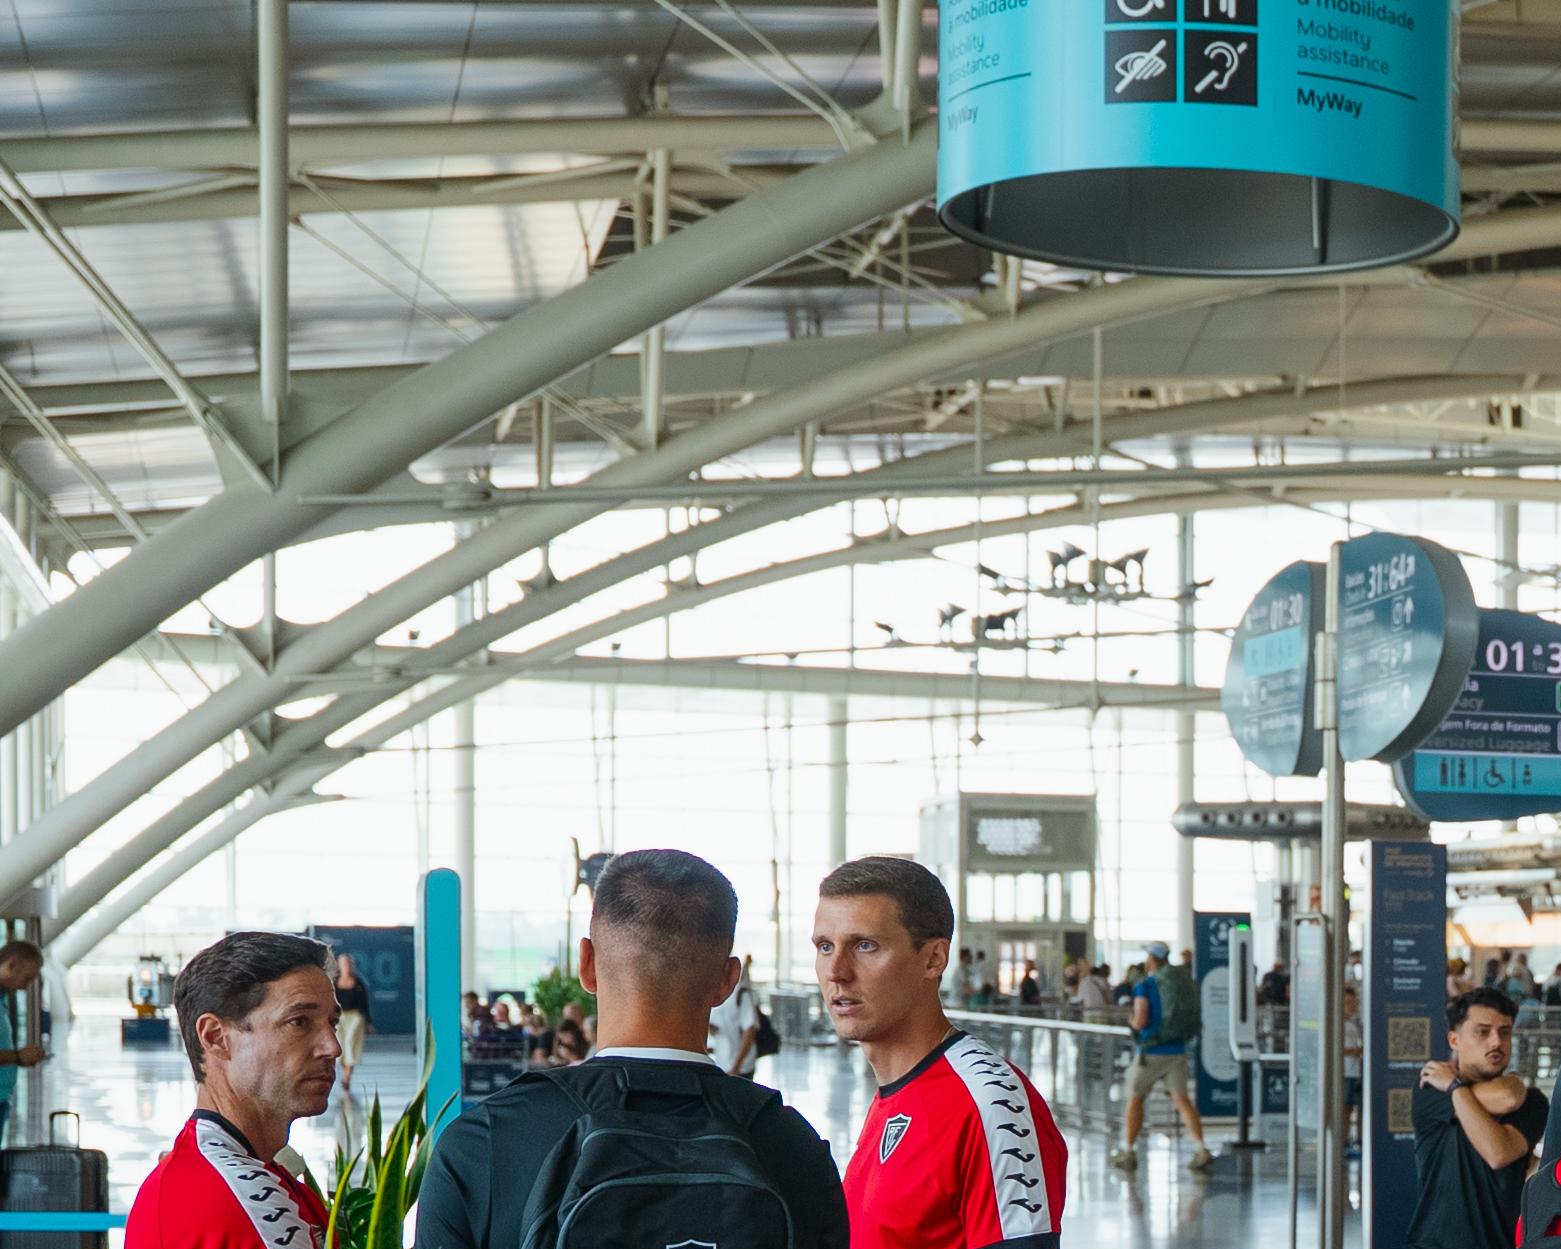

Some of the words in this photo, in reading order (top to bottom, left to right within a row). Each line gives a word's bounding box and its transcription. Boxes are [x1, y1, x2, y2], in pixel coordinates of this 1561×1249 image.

[1297, 18, 1371, 51] Mobility
[1297, 45, 1390, 75] assistance
[1297, 87, 1363, 118] MyWay
[1486, 639, 1524, 672] 01
[1465, 719, 1488, 731] Fora
[1490, 720, 1504, 731] de
[1506, 720, 1551, 734] Formato
